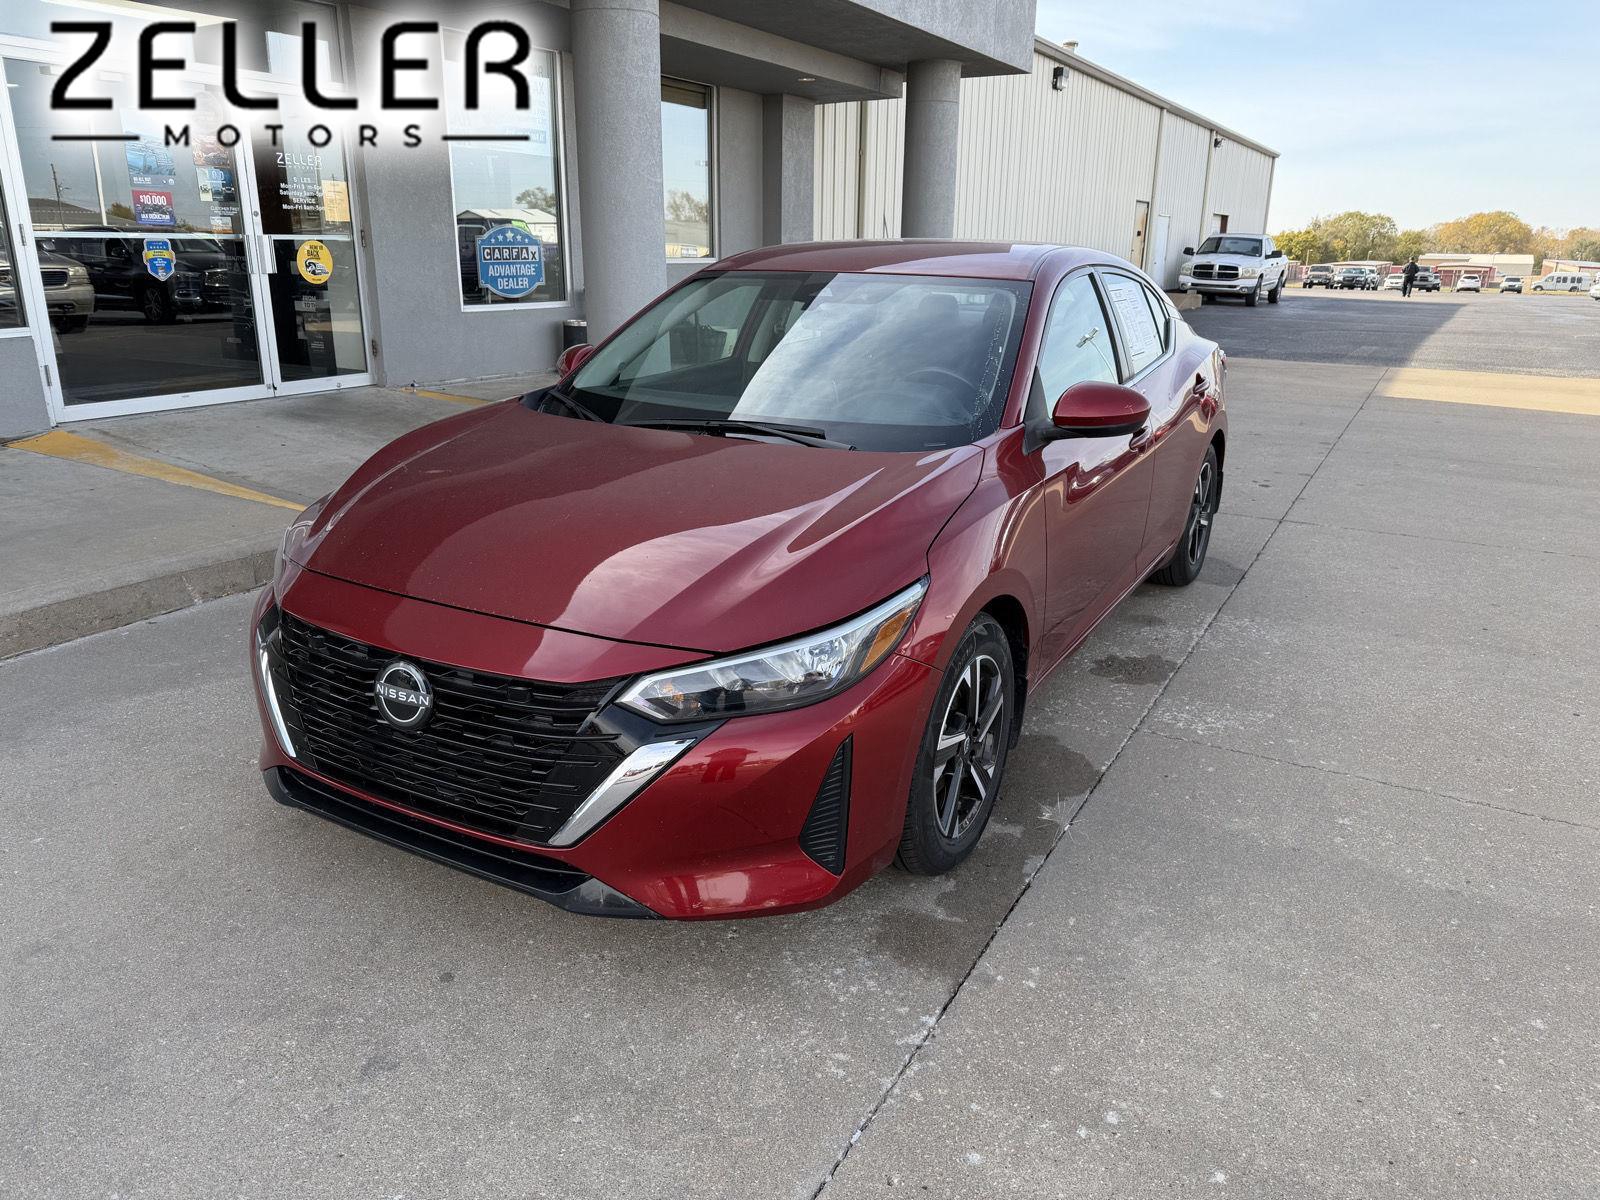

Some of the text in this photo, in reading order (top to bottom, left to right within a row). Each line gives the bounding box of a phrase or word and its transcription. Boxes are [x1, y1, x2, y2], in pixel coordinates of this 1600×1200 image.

[276, 152, 322, 165] ZELLER
[484, 248, 537, 261] CARFAX
[488, 263, 536, 277] ADVANTAGE
[497, 277, 530, 290] DEALER
[376, 683, 429, 706] NISSAN
